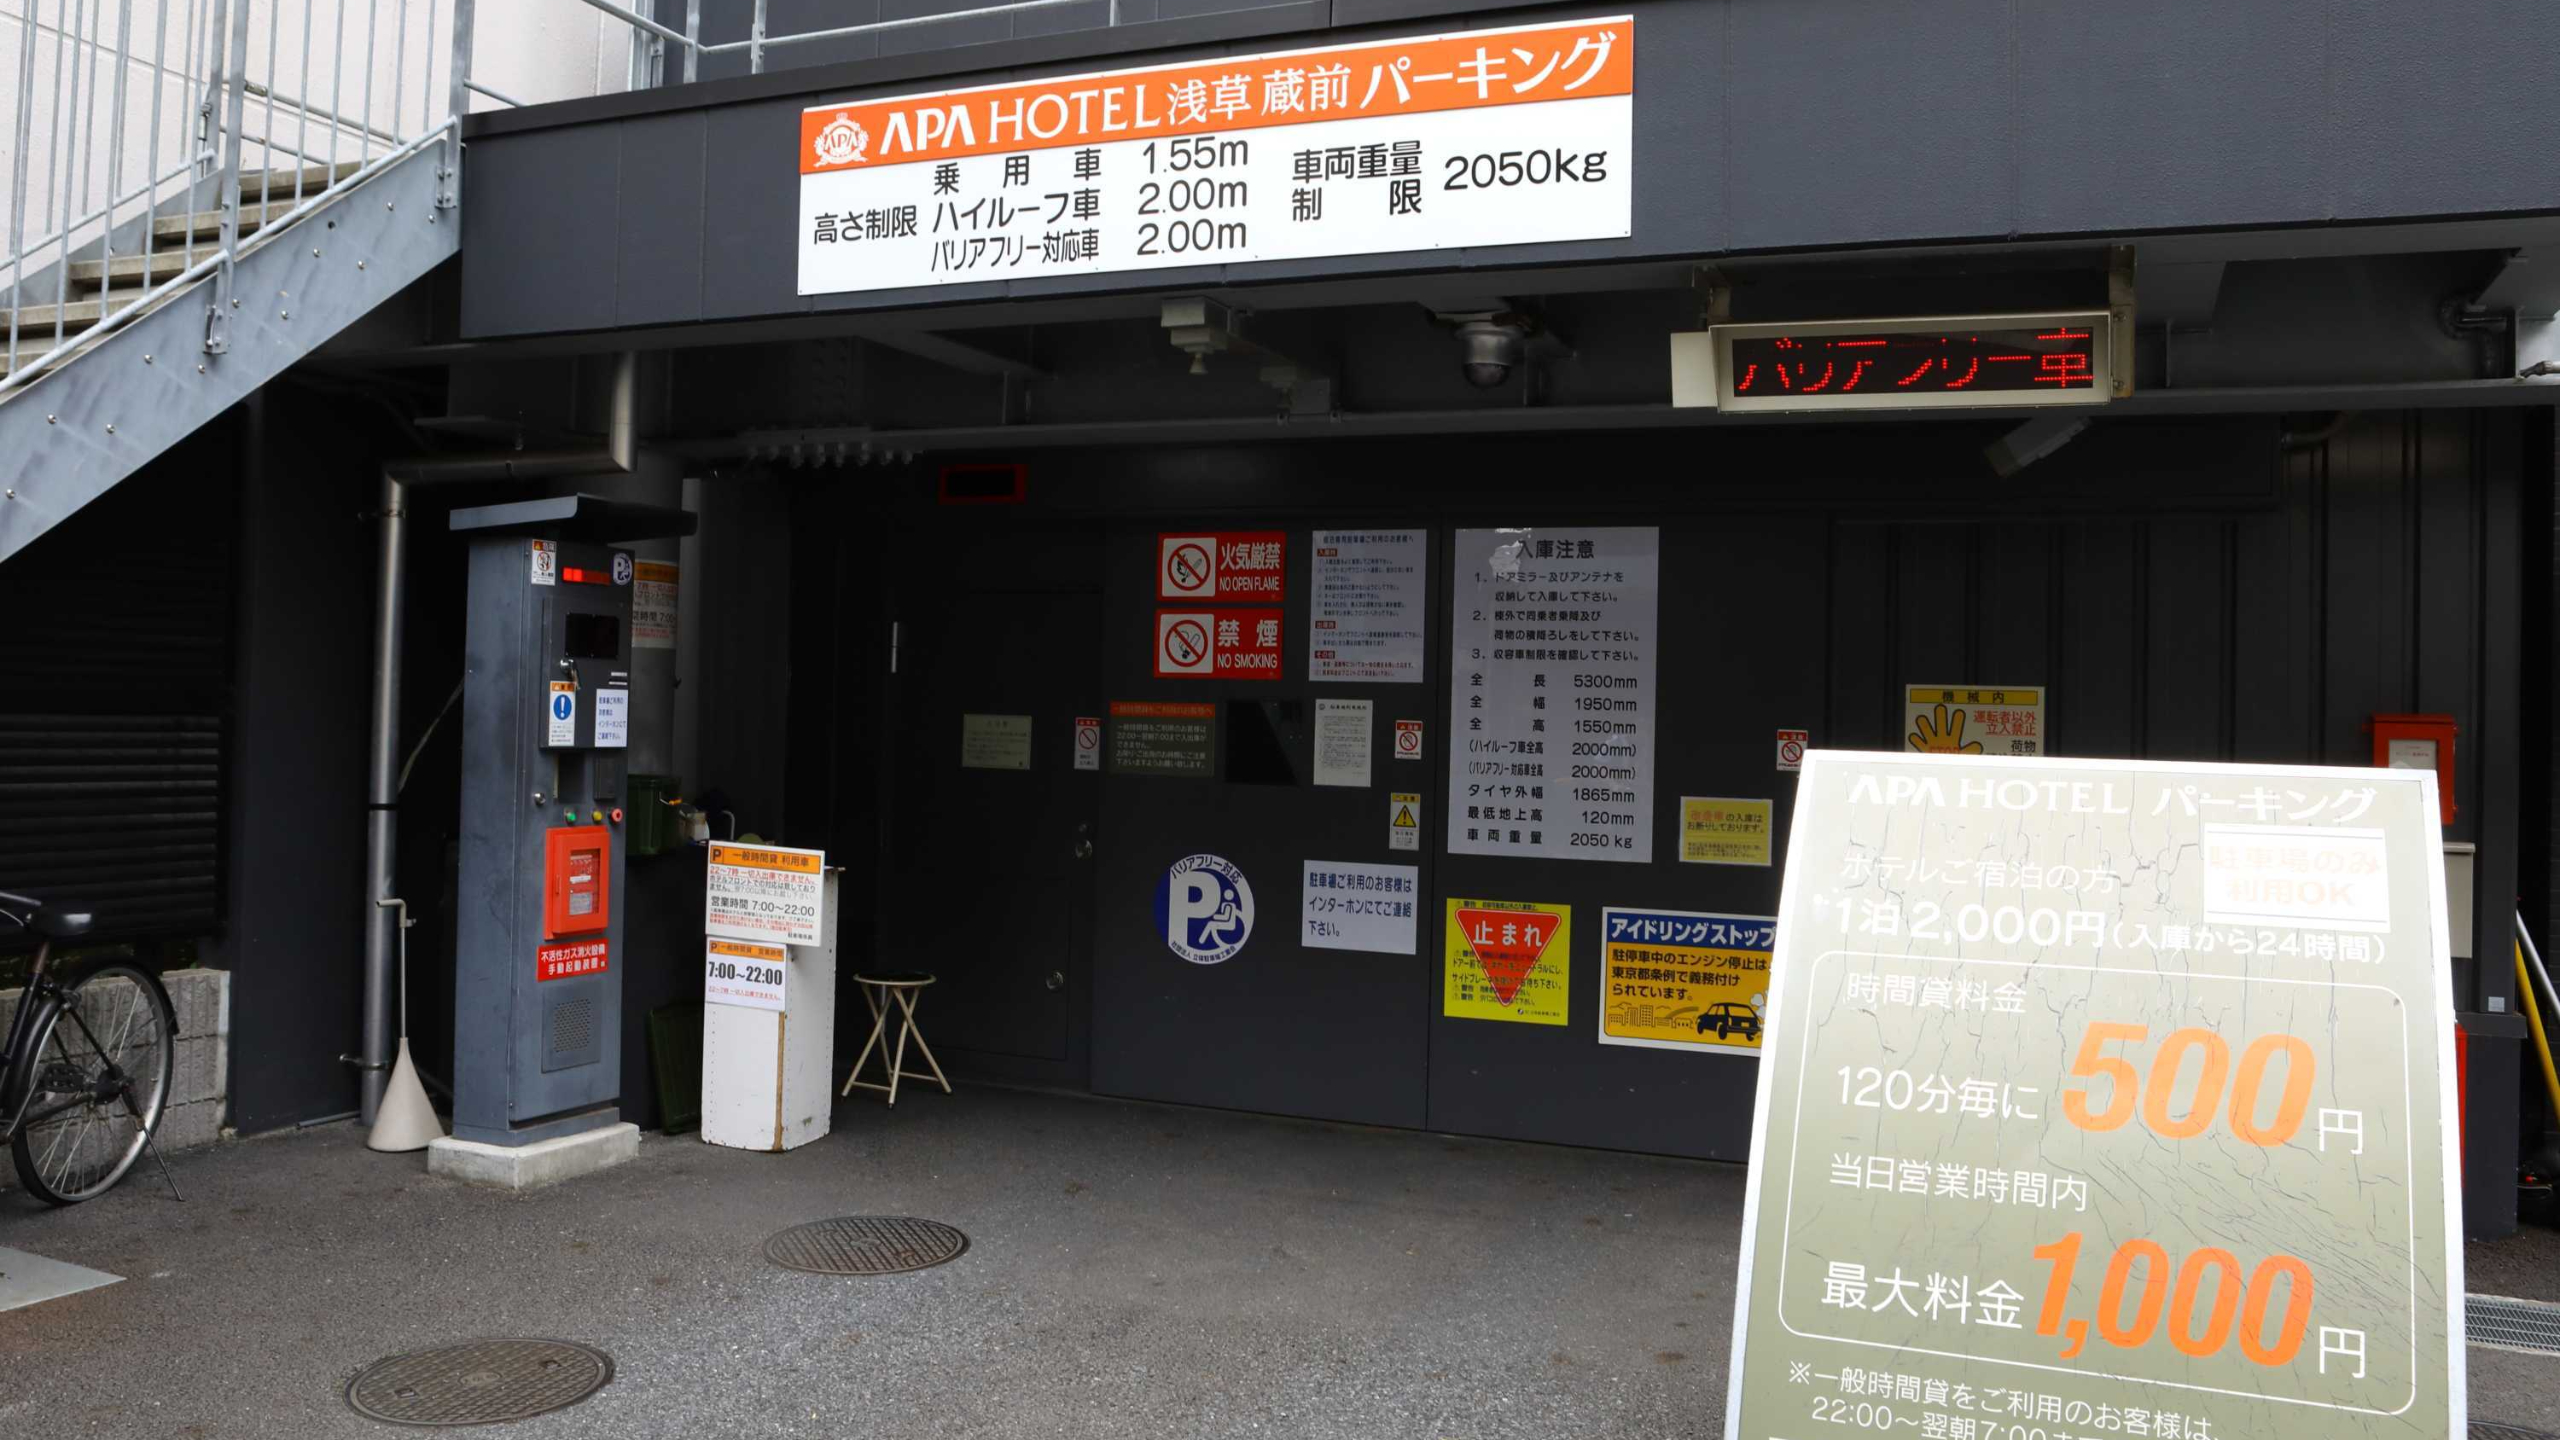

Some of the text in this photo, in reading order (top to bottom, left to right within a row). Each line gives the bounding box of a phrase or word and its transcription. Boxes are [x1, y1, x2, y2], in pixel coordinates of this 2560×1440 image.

[880, 31, 1618, 154] APA HOTEL 浅草 蔵前 パーキング
[1143, 137, 1248, 174] 1.55m
[1292, 140, 1423, 184] 車両重量
[1443, 148, 1608, 190] 2050kg
[933, 177, 1247, 234] ハイルーフ車 2.00m
[814, 205, 918, 246] 高さ制限
[931, 218, 1247, 272] バリアフリー対応車 2.00m
[1220, 542, 1281, 571] 火気厳禁
[1516, 540, 1594, 560] 入庫注意
[1219, 577, 1280, 592] NO OPEN FLAME
[1495, 572, 1624, 583] ドアミラー及びアンテナを
[1495, 591, 1618, 602] 収納して入庫して下さい。
[1494, 630, 1639, 642] 荷物の積降ろしをして下さい。
[1217, 653, 1278, 669] NO SMOKING
[1494, 649, 1639, 661] 収容車制限を確認して下さい。
[1573, 674, 1638, 689] 5300mm
[1574, 697, 1637, 712] 1950mm
[1574, 720, 1637, 735] 1550mm
[1985, 723, 2036, 736] 立入禁止
[1572, 742, 1637, 758] 2000mm)
[2011, 740, 2036, 753] 荷物
[1571, 765, 1636, 780] 2000mm)
[1468, 784, 1635, 803] タイヤ外幅 1865mm
[1848, 774, 2378, 823] APA HOTEL パーキング
[1468, 806, 1635, 826] 最低地上高 120mm
[1467, 828, 1633, 849] 車両重量 2050 kg
[711, 847, 722, 862] P
[2209, 846, 2381, 875] 駐車場のみ
[1171, 855, 1242, 885] バリアフリー対応
[1841, 854, 2117, 894] ホテルご宿泊の方
[1309, 872, 1412, 893] 駐車場ご利用のお客様は
[2227, 878, 2355, 908] 利用OK
[711, 895, 815, 918] 営業時間 7:00～22:00
[1308, 896, 1412, 918] インターホンにてご連絡
[1308, 920, 1341, 937] 下さい。
[1473, 920, 1543, 948] 止まれ
[1611, 918, 1776, 947] アイドリングストップ
[710, 942, 718, 951] P
[708, 961, 783, 985] 7:00～22:00
[1612, 966, 1740, 987] 東京都条例で義務付け
[1612, 984, 1693, 1001] られています。
[1847, 972, 2027, 1014] 時間貸料金
[1836, 1020, 2364, 1156] 120分毎に 500 円
[1829, 1151, 2088, 1213] 当日営業時間内
[1822, 1231, 2366, 1380] 最大料金 1,000 円
